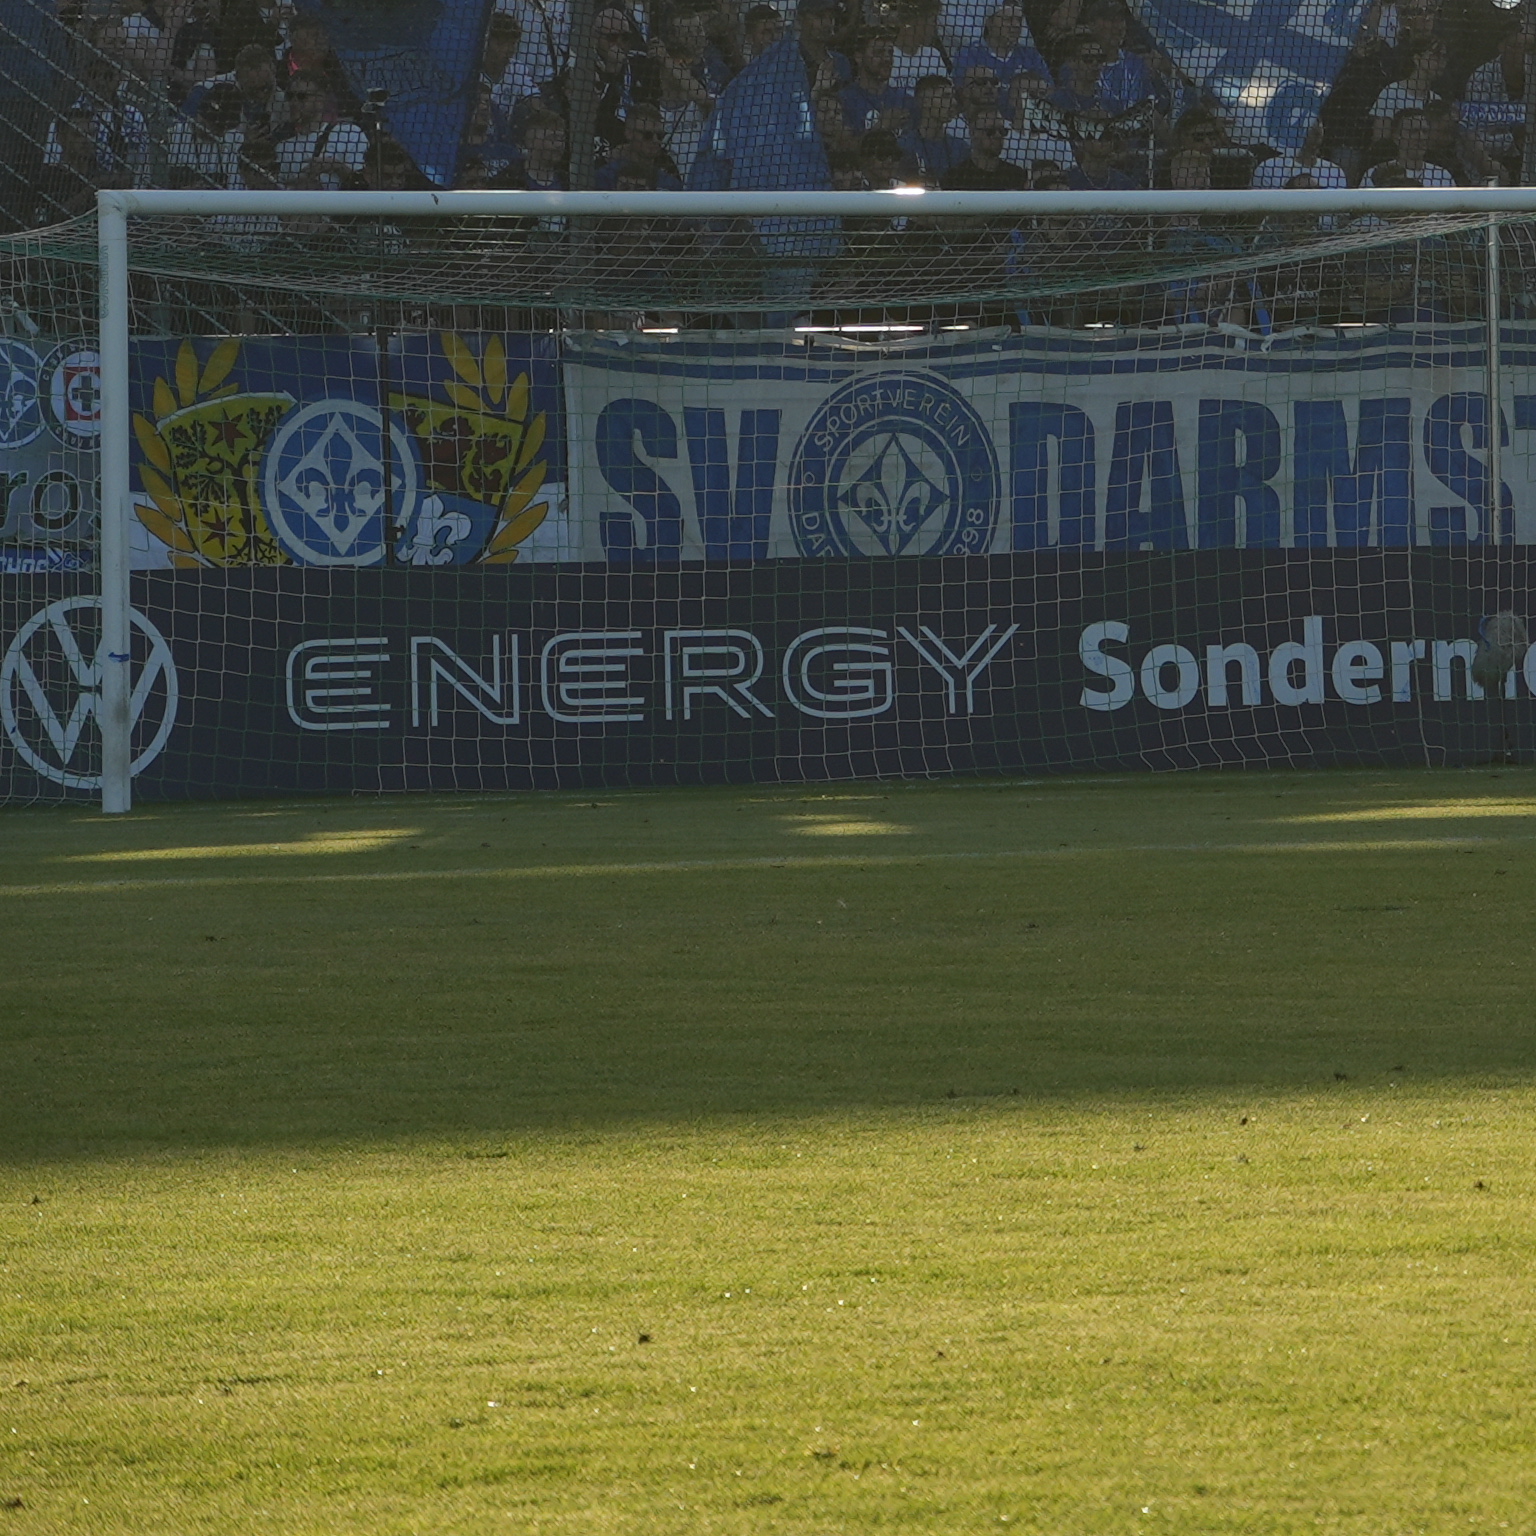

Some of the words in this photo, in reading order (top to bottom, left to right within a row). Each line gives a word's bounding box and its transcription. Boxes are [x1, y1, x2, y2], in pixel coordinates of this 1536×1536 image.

[813, 388, 971, 452] SPORTVEREIN
[597, 398, 783, 561] SV
[285, 622, 1021, 732] ENERGY
